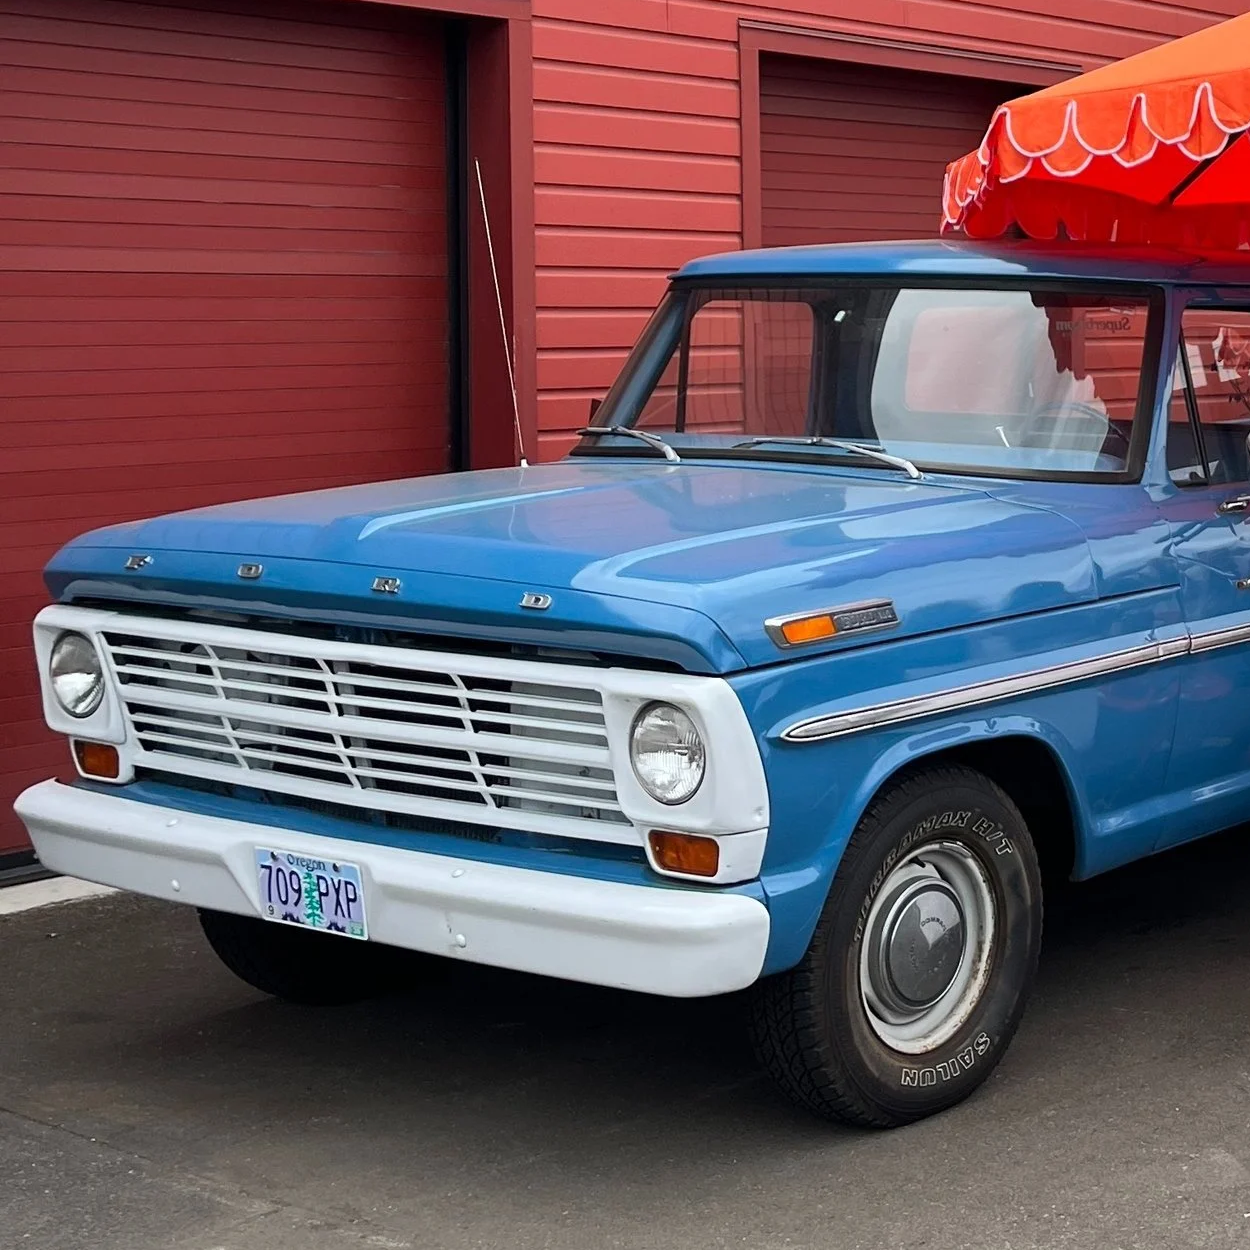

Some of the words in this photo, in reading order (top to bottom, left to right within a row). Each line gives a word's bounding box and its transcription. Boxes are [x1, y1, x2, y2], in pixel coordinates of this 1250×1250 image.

[123, 553, 554, 610] FORD
[287, 853, 327, 872] Oregon
[971, 816, 1015, 856] H/T
[260, 863, 302, 907] 709
[316, 874, 358, 919] PXP
[900, 1031, 992, 1088] SAILUN
